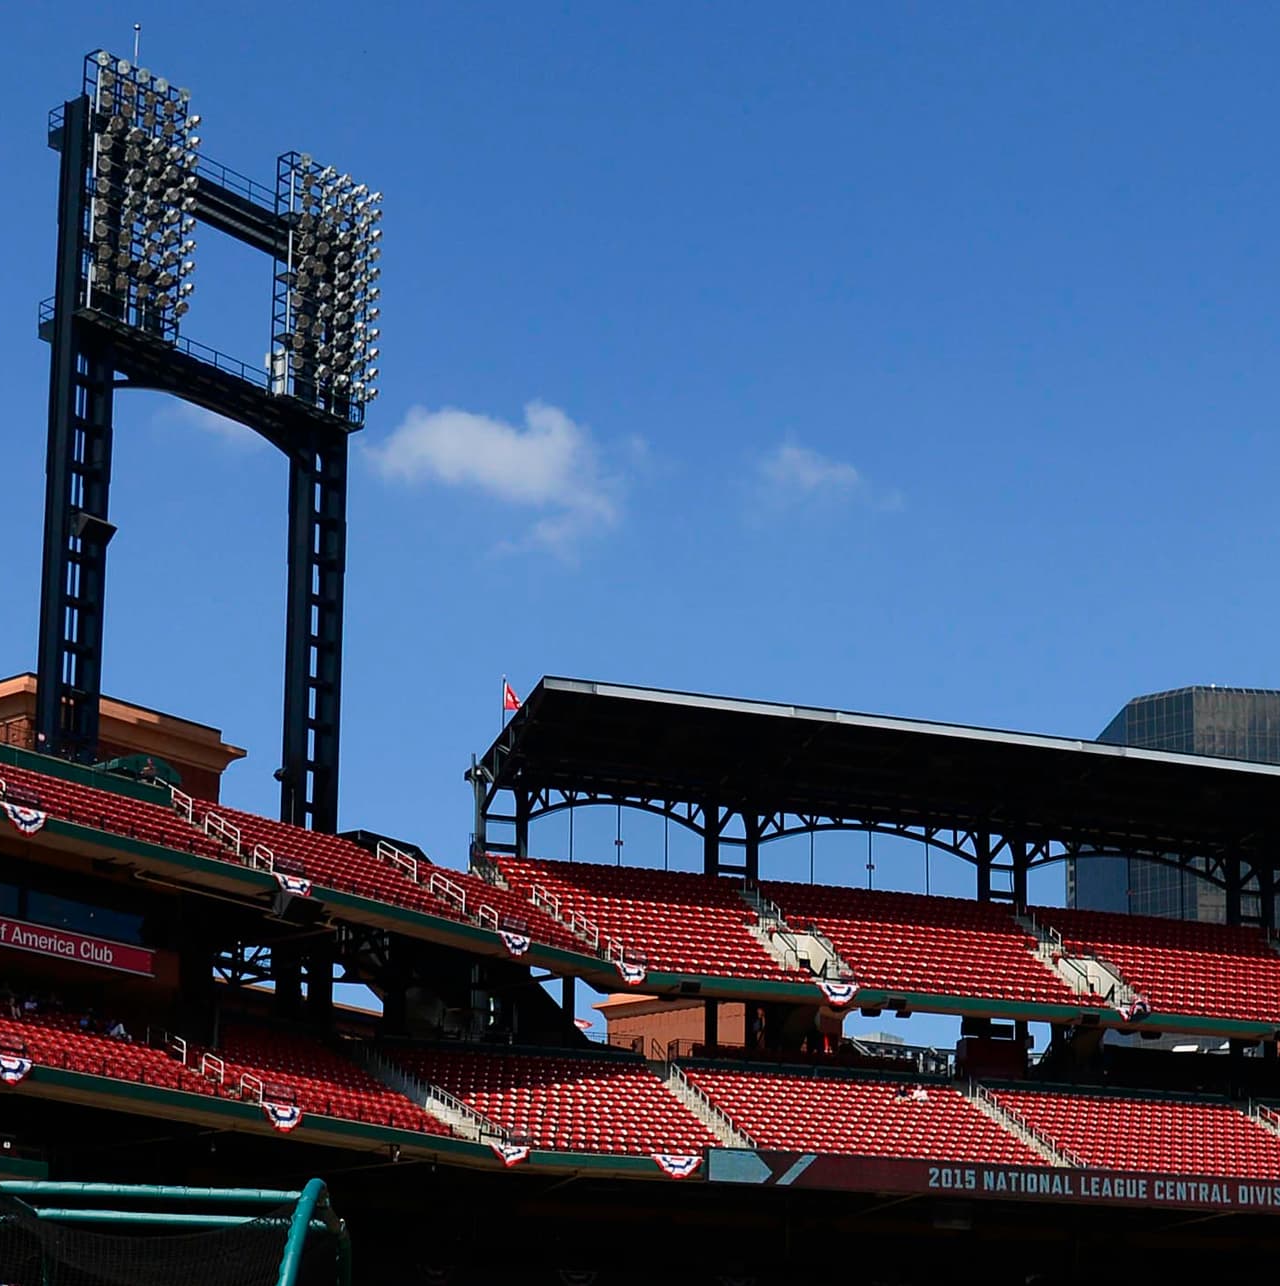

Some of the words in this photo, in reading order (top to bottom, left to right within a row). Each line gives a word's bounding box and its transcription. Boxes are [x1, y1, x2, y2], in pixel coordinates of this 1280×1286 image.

[11, 927, 75, 955] America
[80, 941, 113, 963] Club
[928, 1167, 975, 1189] 2015
[983, 1170, 1073, 1195] NATIONAL
[1081, 1176, 1148, 1199] LEAGUE
[1154, 1180, 1231, 1204] CENTRAL
